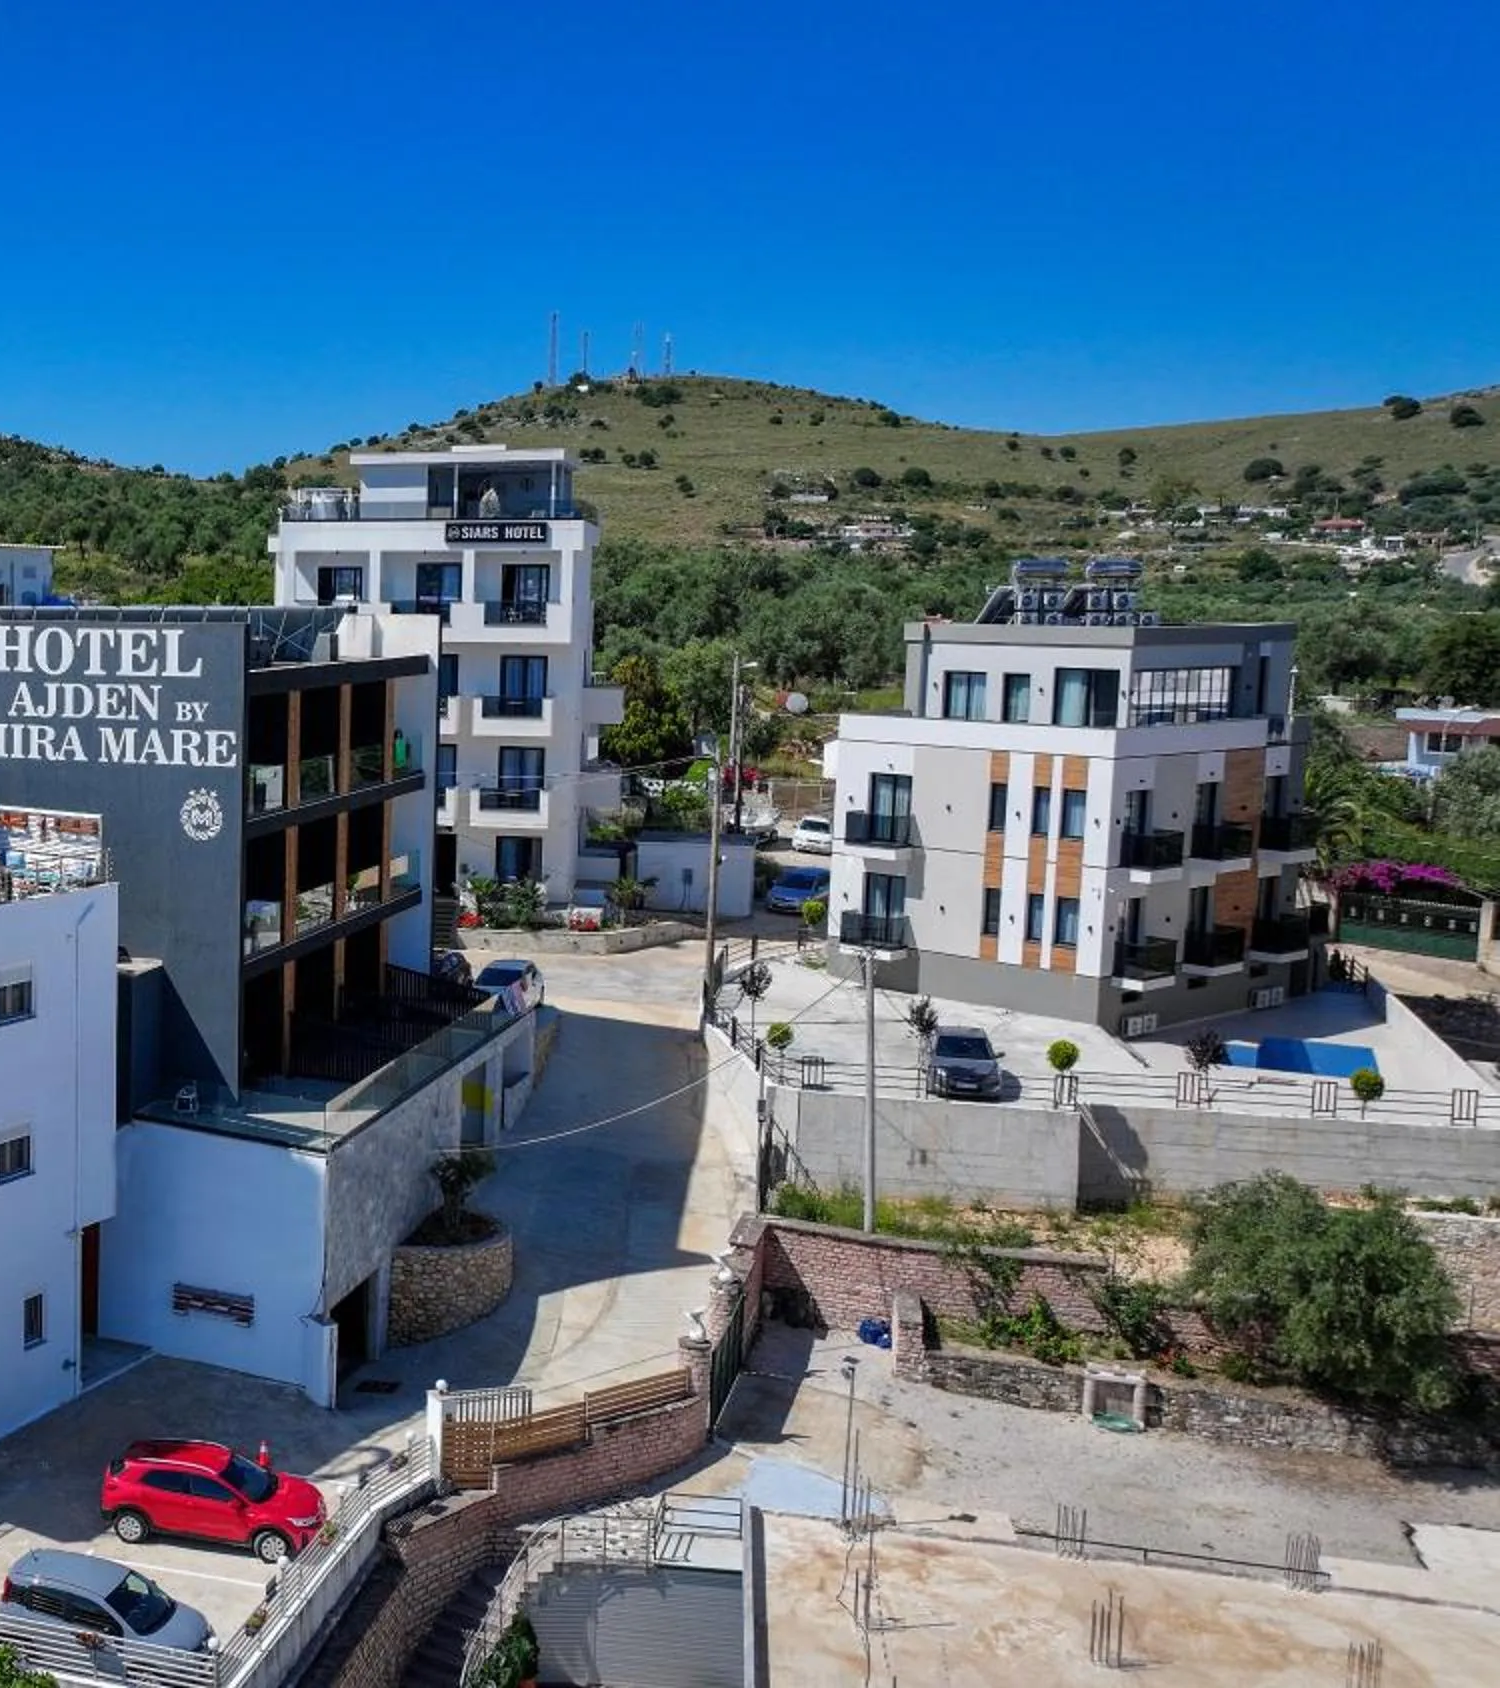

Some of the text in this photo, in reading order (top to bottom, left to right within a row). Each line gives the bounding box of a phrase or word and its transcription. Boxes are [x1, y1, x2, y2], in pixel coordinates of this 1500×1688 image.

[461, 526, 545, 539] SIARS HOTEL
[7, 681, 210, 722] AJDEN BY
[97, 727, 237, 768] MARE
